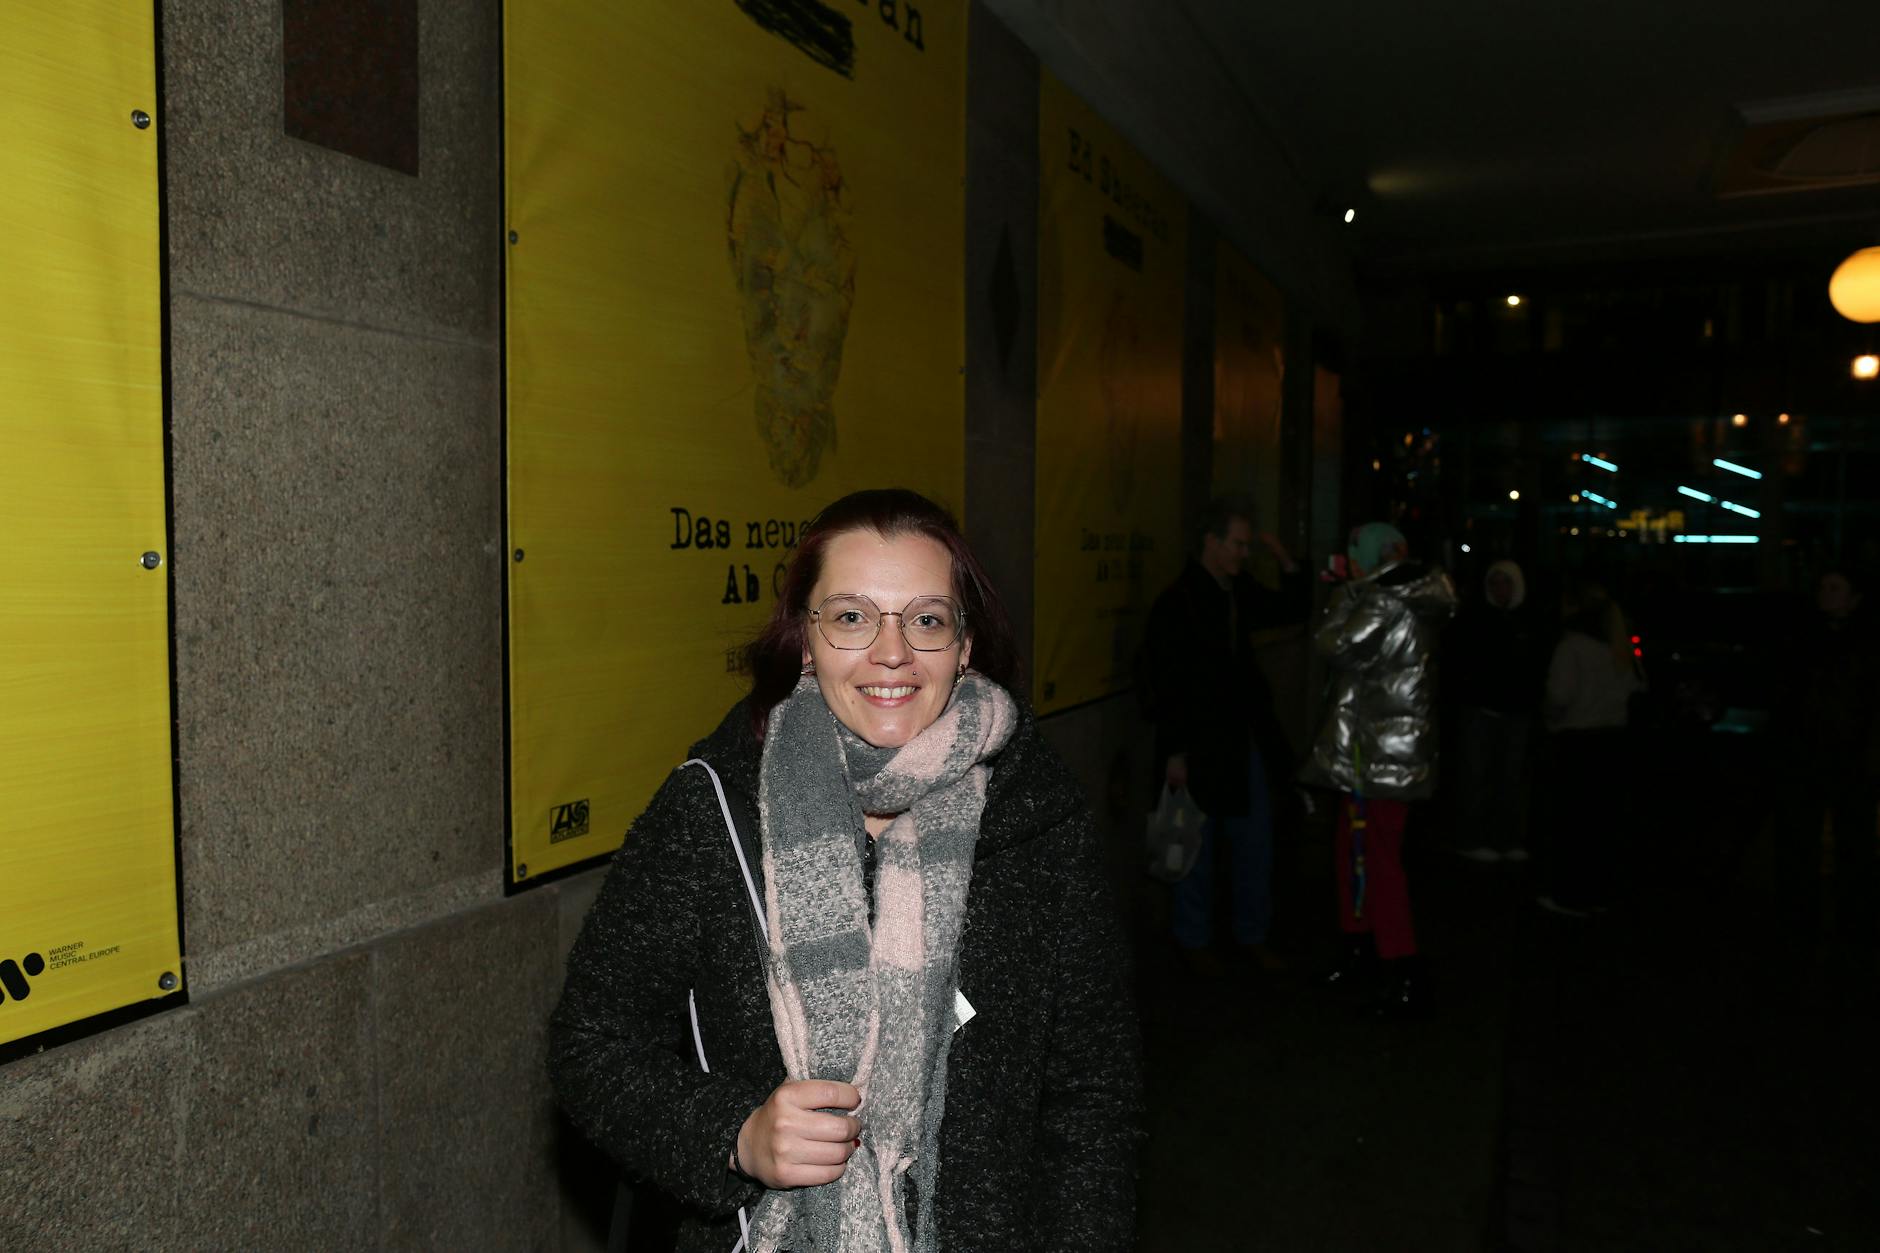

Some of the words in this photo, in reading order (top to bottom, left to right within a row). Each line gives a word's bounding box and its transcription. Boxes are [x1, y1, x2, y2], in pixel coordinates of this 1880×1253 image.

[857, 0, 925, 51] an
[670, 507, 731, 549] Das
[721, 564, 760, 604] Ab
[49, 941, 84, 956] WARNER
[50, 951, 76, 963] MUSIC
[50, 955, 87, 970] CENTRAL
[89, 945, 120, 960] EUROPE
